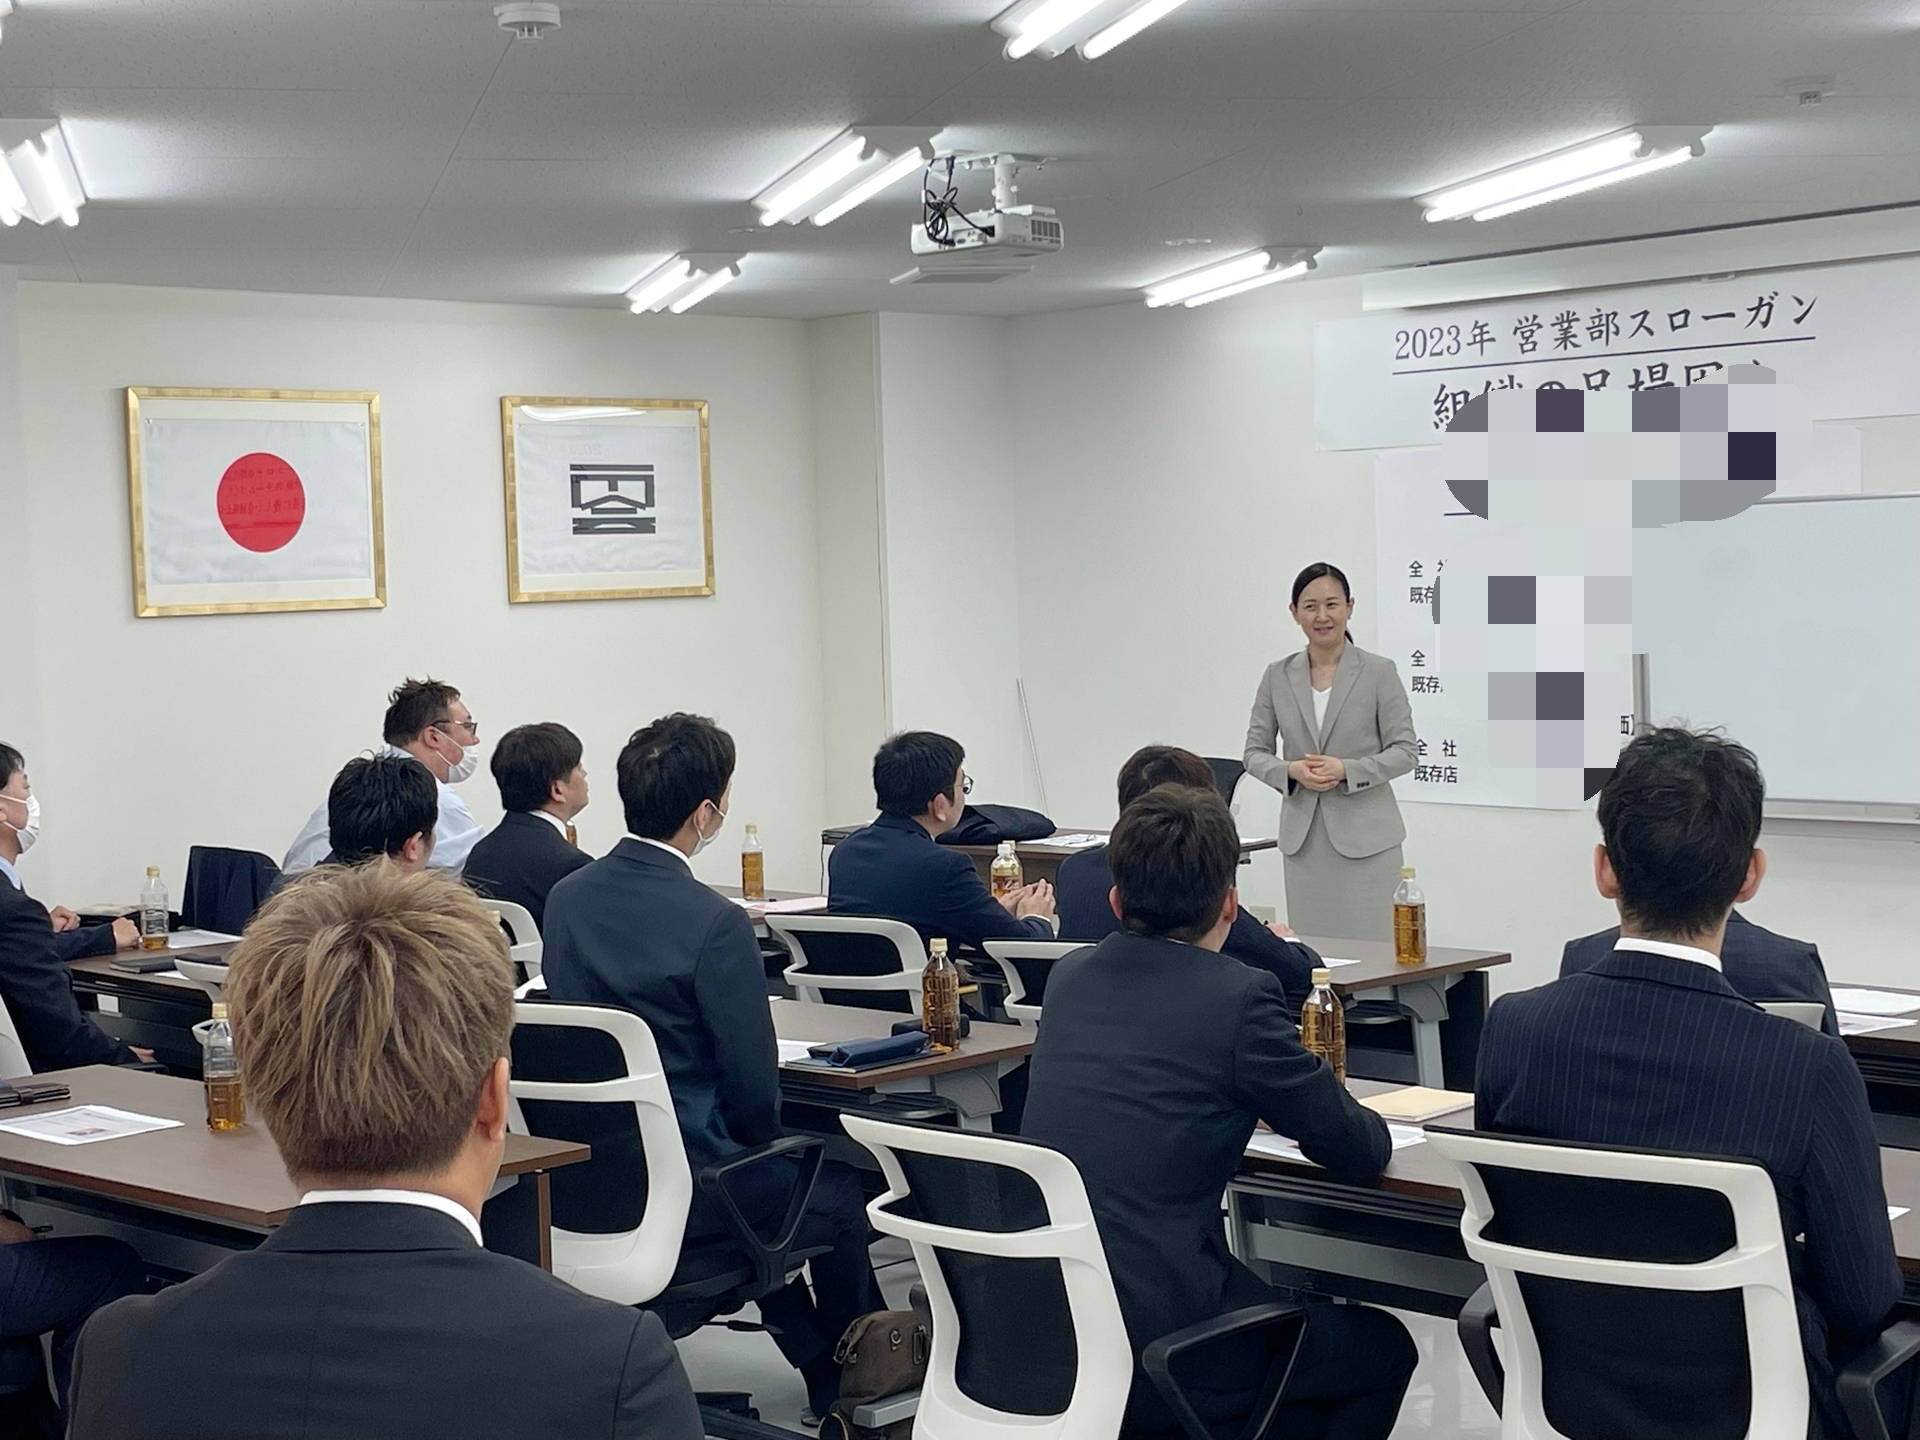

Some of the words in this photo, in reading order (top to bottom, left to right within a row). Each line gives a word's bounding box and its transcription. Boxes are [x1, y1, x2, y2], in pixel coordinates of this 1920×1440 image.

[1395, 320, 1496, 360] 2023年
[1512, 291, 1818, 355] 営業部スローガン
[1411, 649, 1425, 667] 全
[1411, 675, 1444, 694] 既存
[1414, 764, 1458, 783] 既存店
